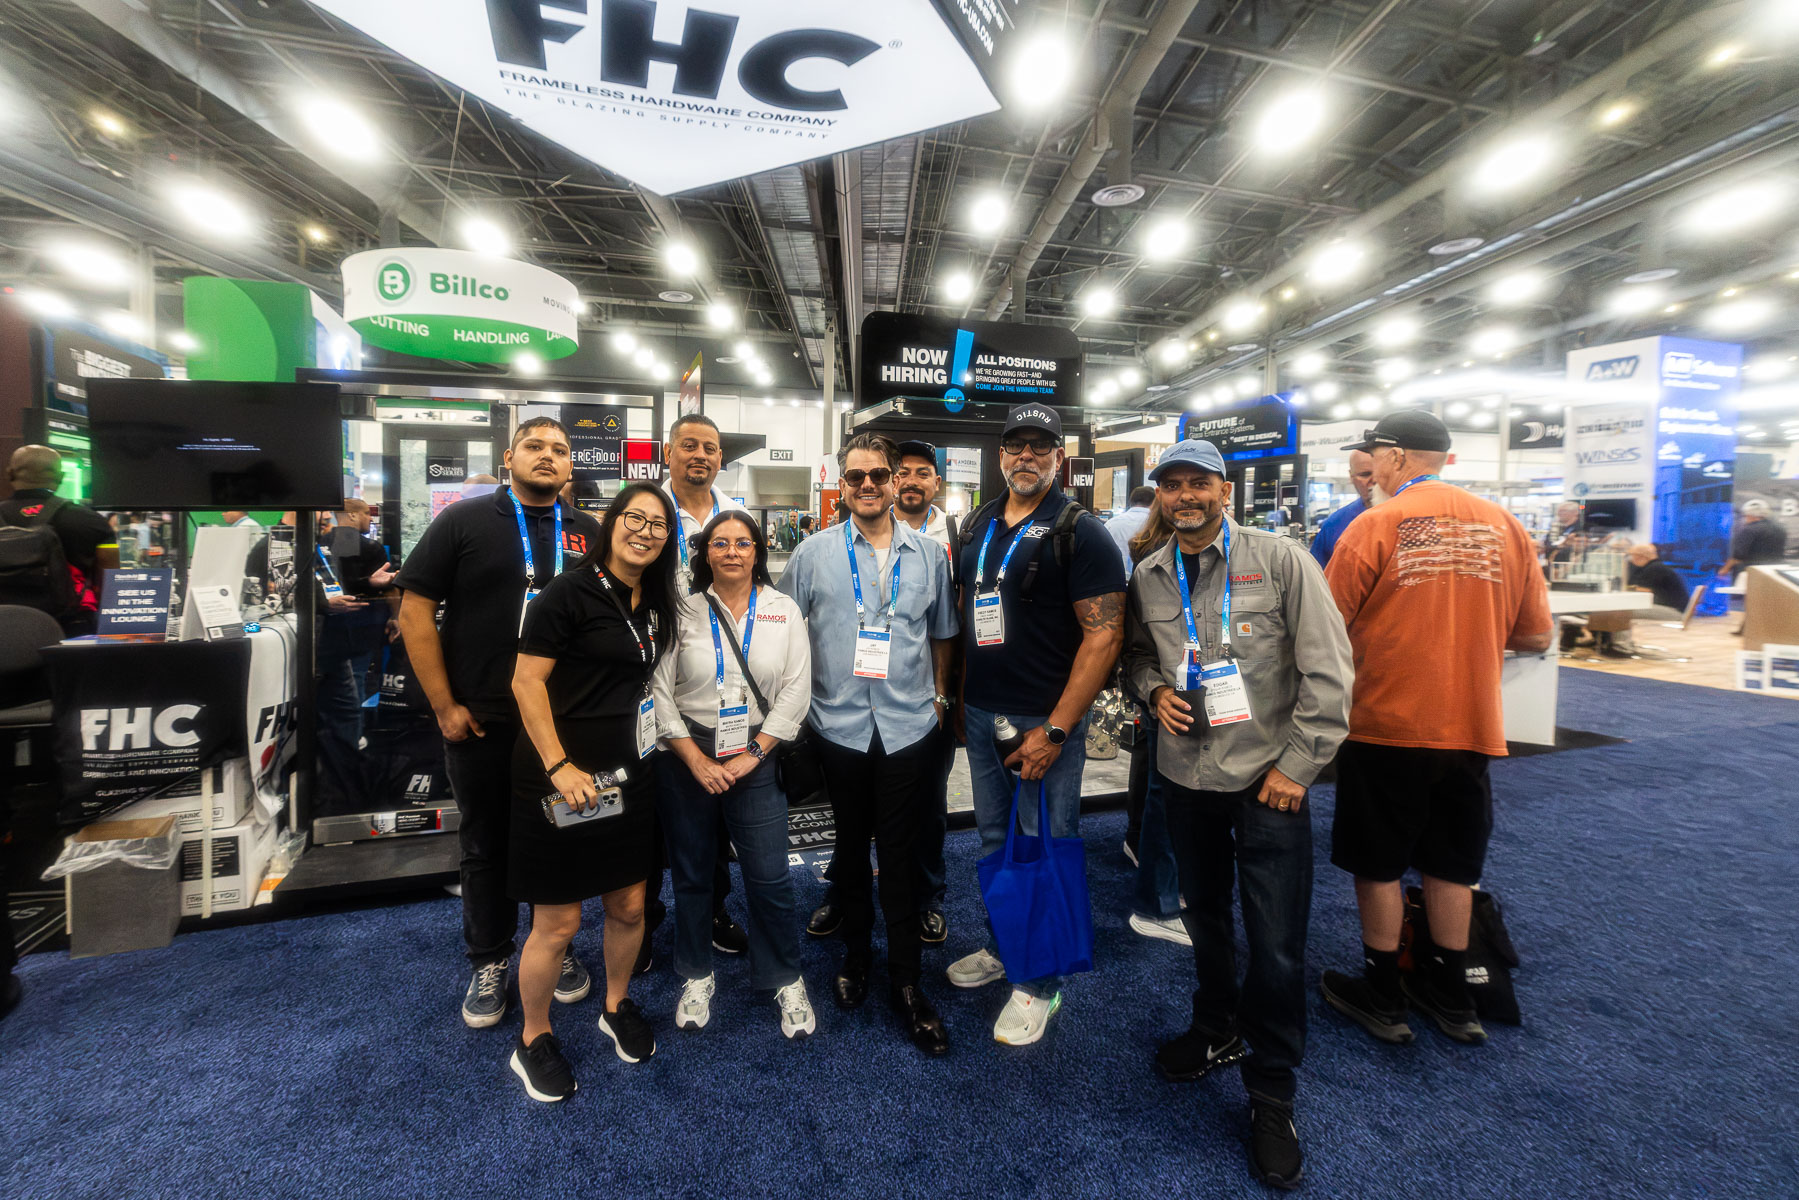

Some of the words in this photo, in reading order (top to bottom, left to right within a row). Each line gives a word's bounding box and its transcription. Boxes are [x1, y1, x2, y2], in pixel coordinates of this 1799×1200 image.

[485, 0, 882, 110] FHC
[498, 69, 625, 100] FRAMELESS
[630, 93, 742, 117] HARDWARE
[747, 111, 838, 127] COMPANY
[503, 88, 541, 100] THE
[557, 96, 645, 118] GLAZING
[659, 114, 731, 129] SUPPLY
[744, 125, 829, 139] COMPANY
[429, 273, 510, 301] Billco
[368, 315, 430, 337] CUTTING
[453, 328, 530, 345] HANDLING
[902, 347, 948, 366] NOW
[976, 354, 997, 365] ALL
[998, 355, 1057, 371] POSITIONS
[881, 365, 948, 385] HIRING
[975, 375, 1000, 384] BRINGING
[1000, 377, 1016, 385] GREAT
[1016, 378, 1035, 386] PEOPLE
[1036, 379, 1049, 387] WITH
[992, 369, 1017, 378] GROWING
[1015, 386, 1038, 394] WINNING
[1016, 410, 1051, 424] RUSTIC
[1199, 416, 1238, 431] FUTURE
[1204, 427, 1229, 437] Entrance
[1229, 424, 1255, 434] Systems
[771, 451, 792, 460] EXIT
[627, 463, 661, 479] NEW
[1072, 474, 1094, 487] NEW
[117, 589, 139, 597] SEE
[140, 589, 157, 597] US
[101, 607, 168, 615] INNOVATION
[756, 613, 787, 622] RAMOS
[80, 704, 202, 751] FHC
